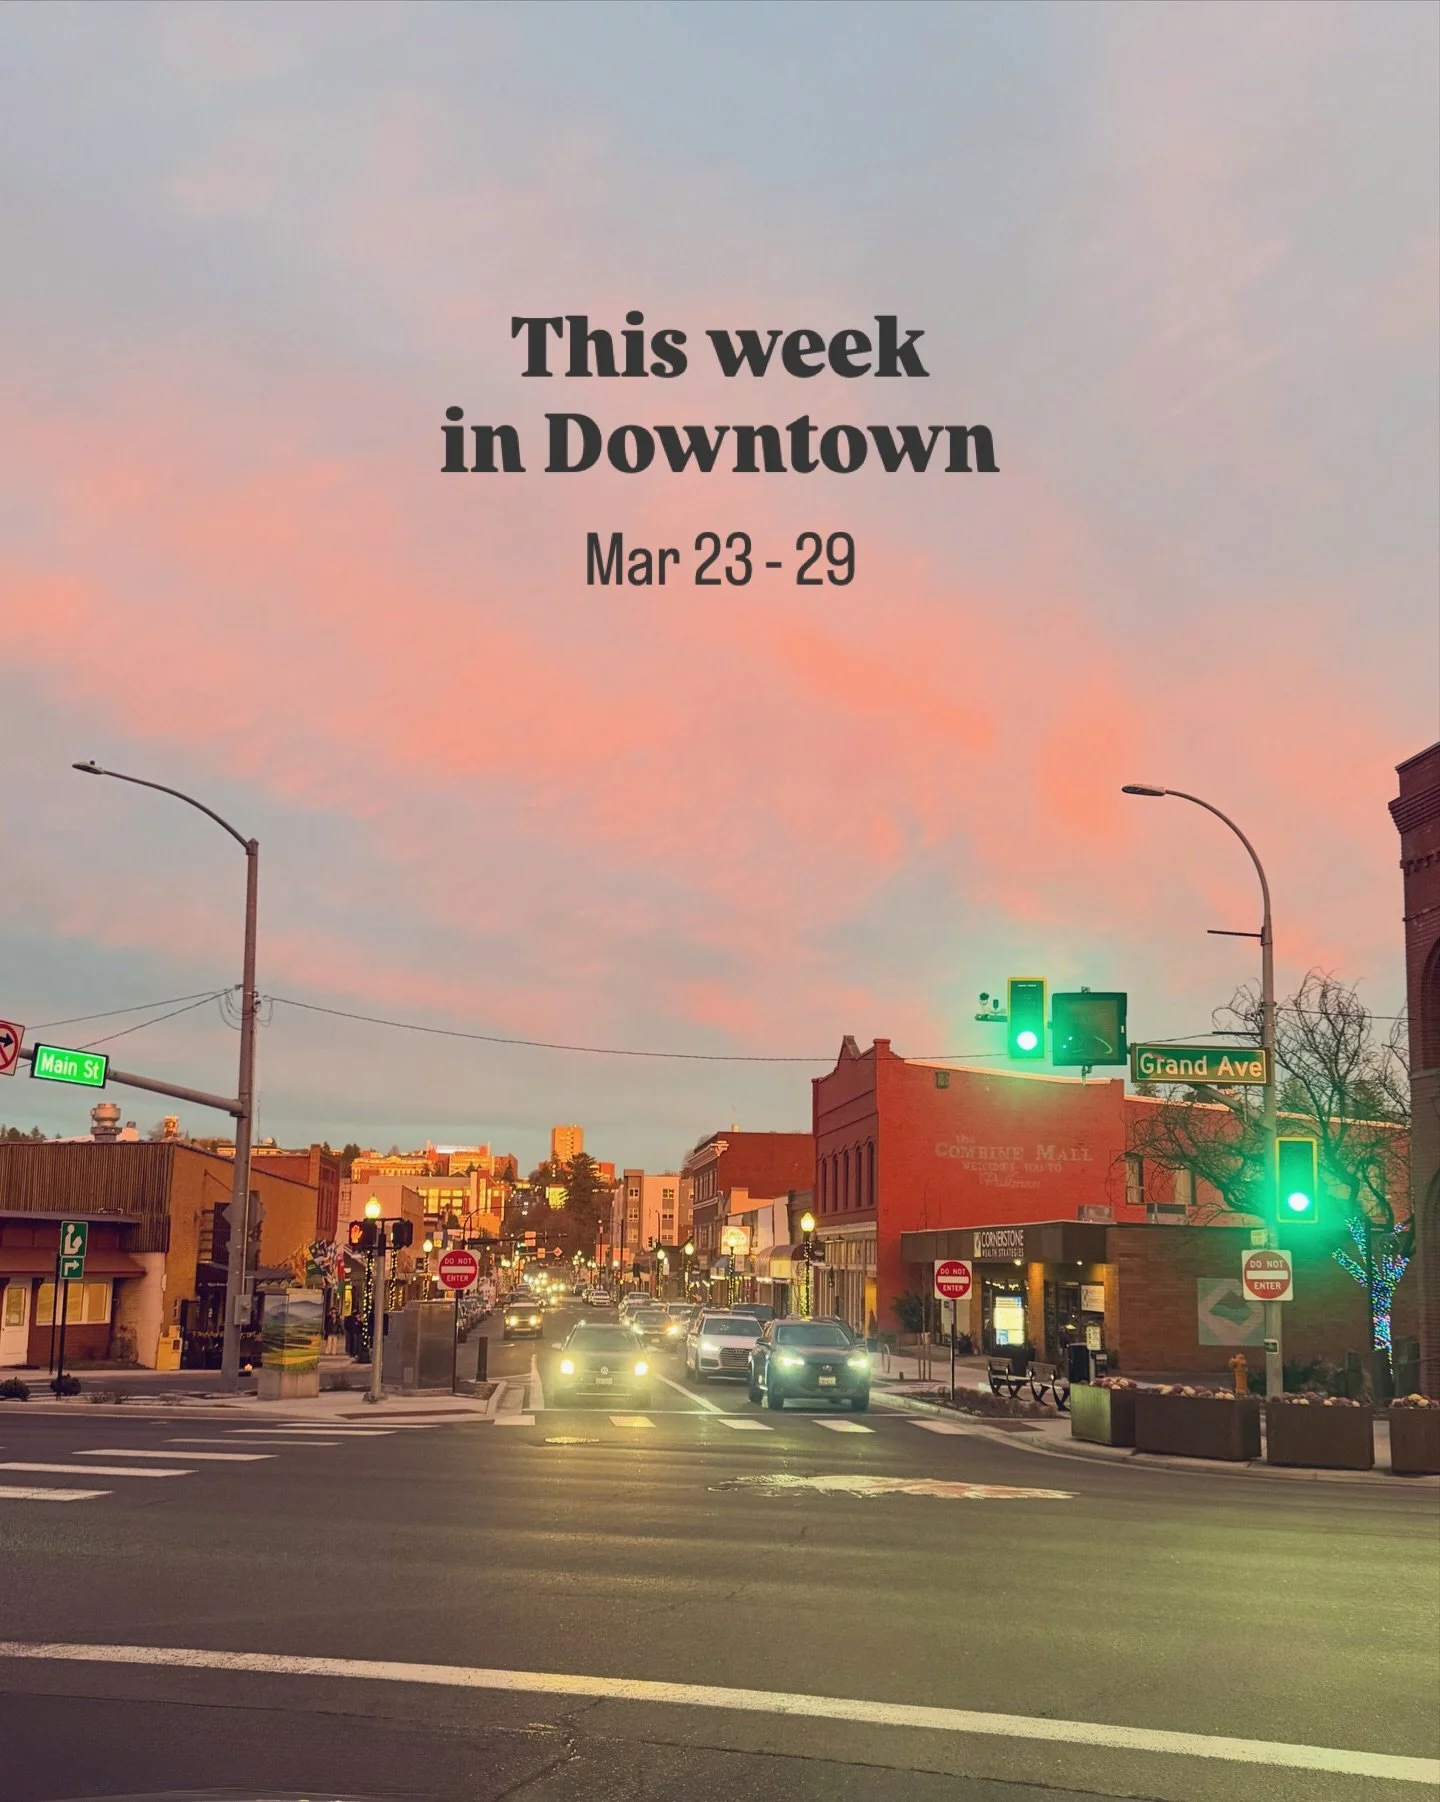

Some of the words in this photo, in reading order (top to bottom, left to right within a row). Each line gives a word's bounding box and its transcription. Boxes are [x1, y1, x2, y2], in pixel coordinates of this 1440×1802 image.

[41, 1052, 78, 1077] Main
[84, 1060, 99, 1079] St
[1140, 1053, 1208, 1076] Grand
[1217, 1056, 1263, 1077] Ave
[981, 1229, 1024, 1248] CORNERSTONE
[444, 1257, 455, 1265] DO
[457, 1257, 473, 1265] NOT
[1249, 1259, 1263, 1269] DO
[1266, 1259, 1285, 1269] NOT
[940, 1267, 951, 1276] DO
[952, 1267, 966, 1276] NOT
[446, 1274, 469, 1282] ENTER
[942, 1284, 964, 1292] ENTER
[1253, 1281, 1282, 1290] ENTER
